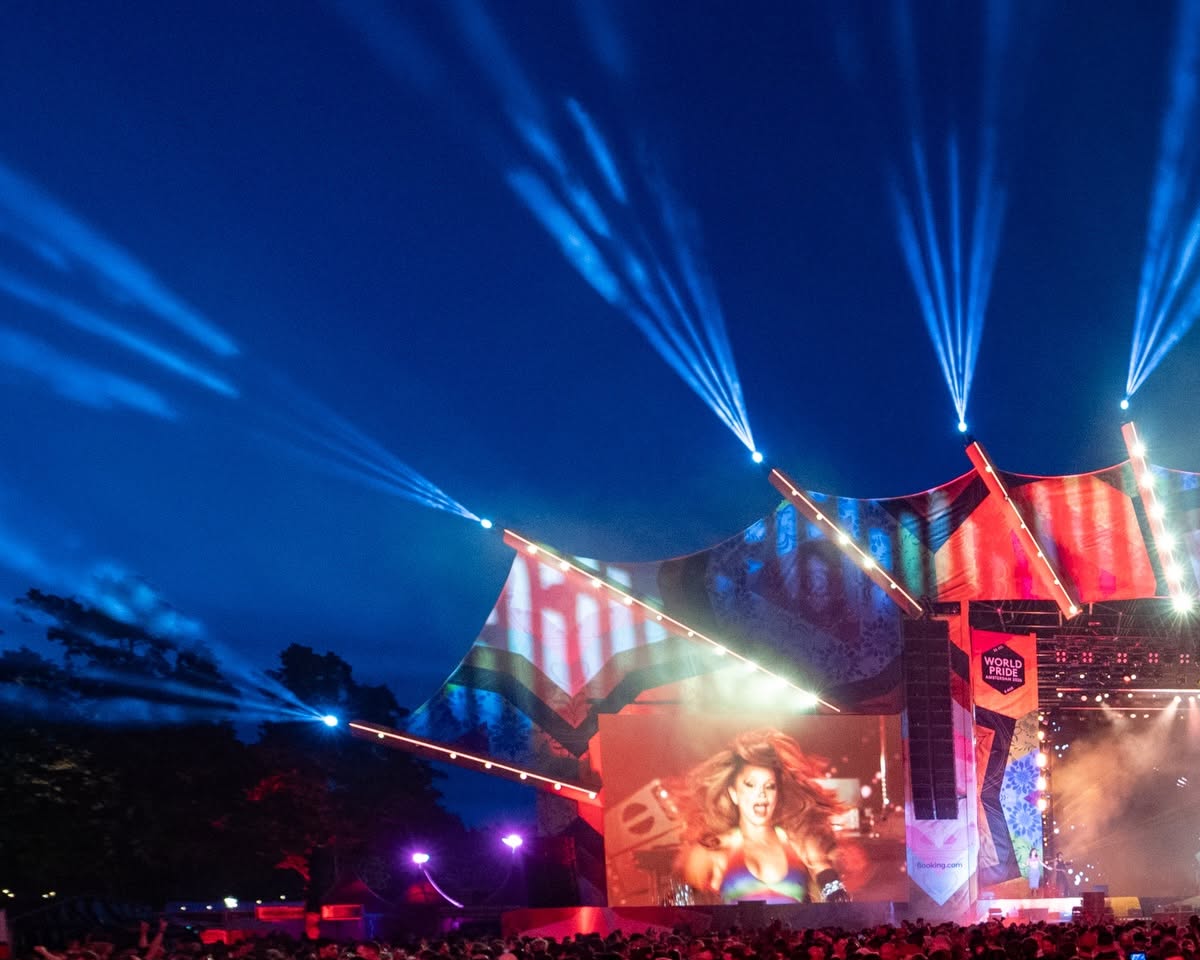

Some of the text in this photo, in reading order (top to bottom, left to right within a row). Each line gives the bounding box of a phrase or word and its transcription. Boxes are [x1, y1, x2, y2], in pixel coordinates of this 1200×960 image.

[984, 656, 1023, 669] WORLD
[989, 666, 1018, 678] PRIDE
[917, 862, 963, 870] Booking.com
